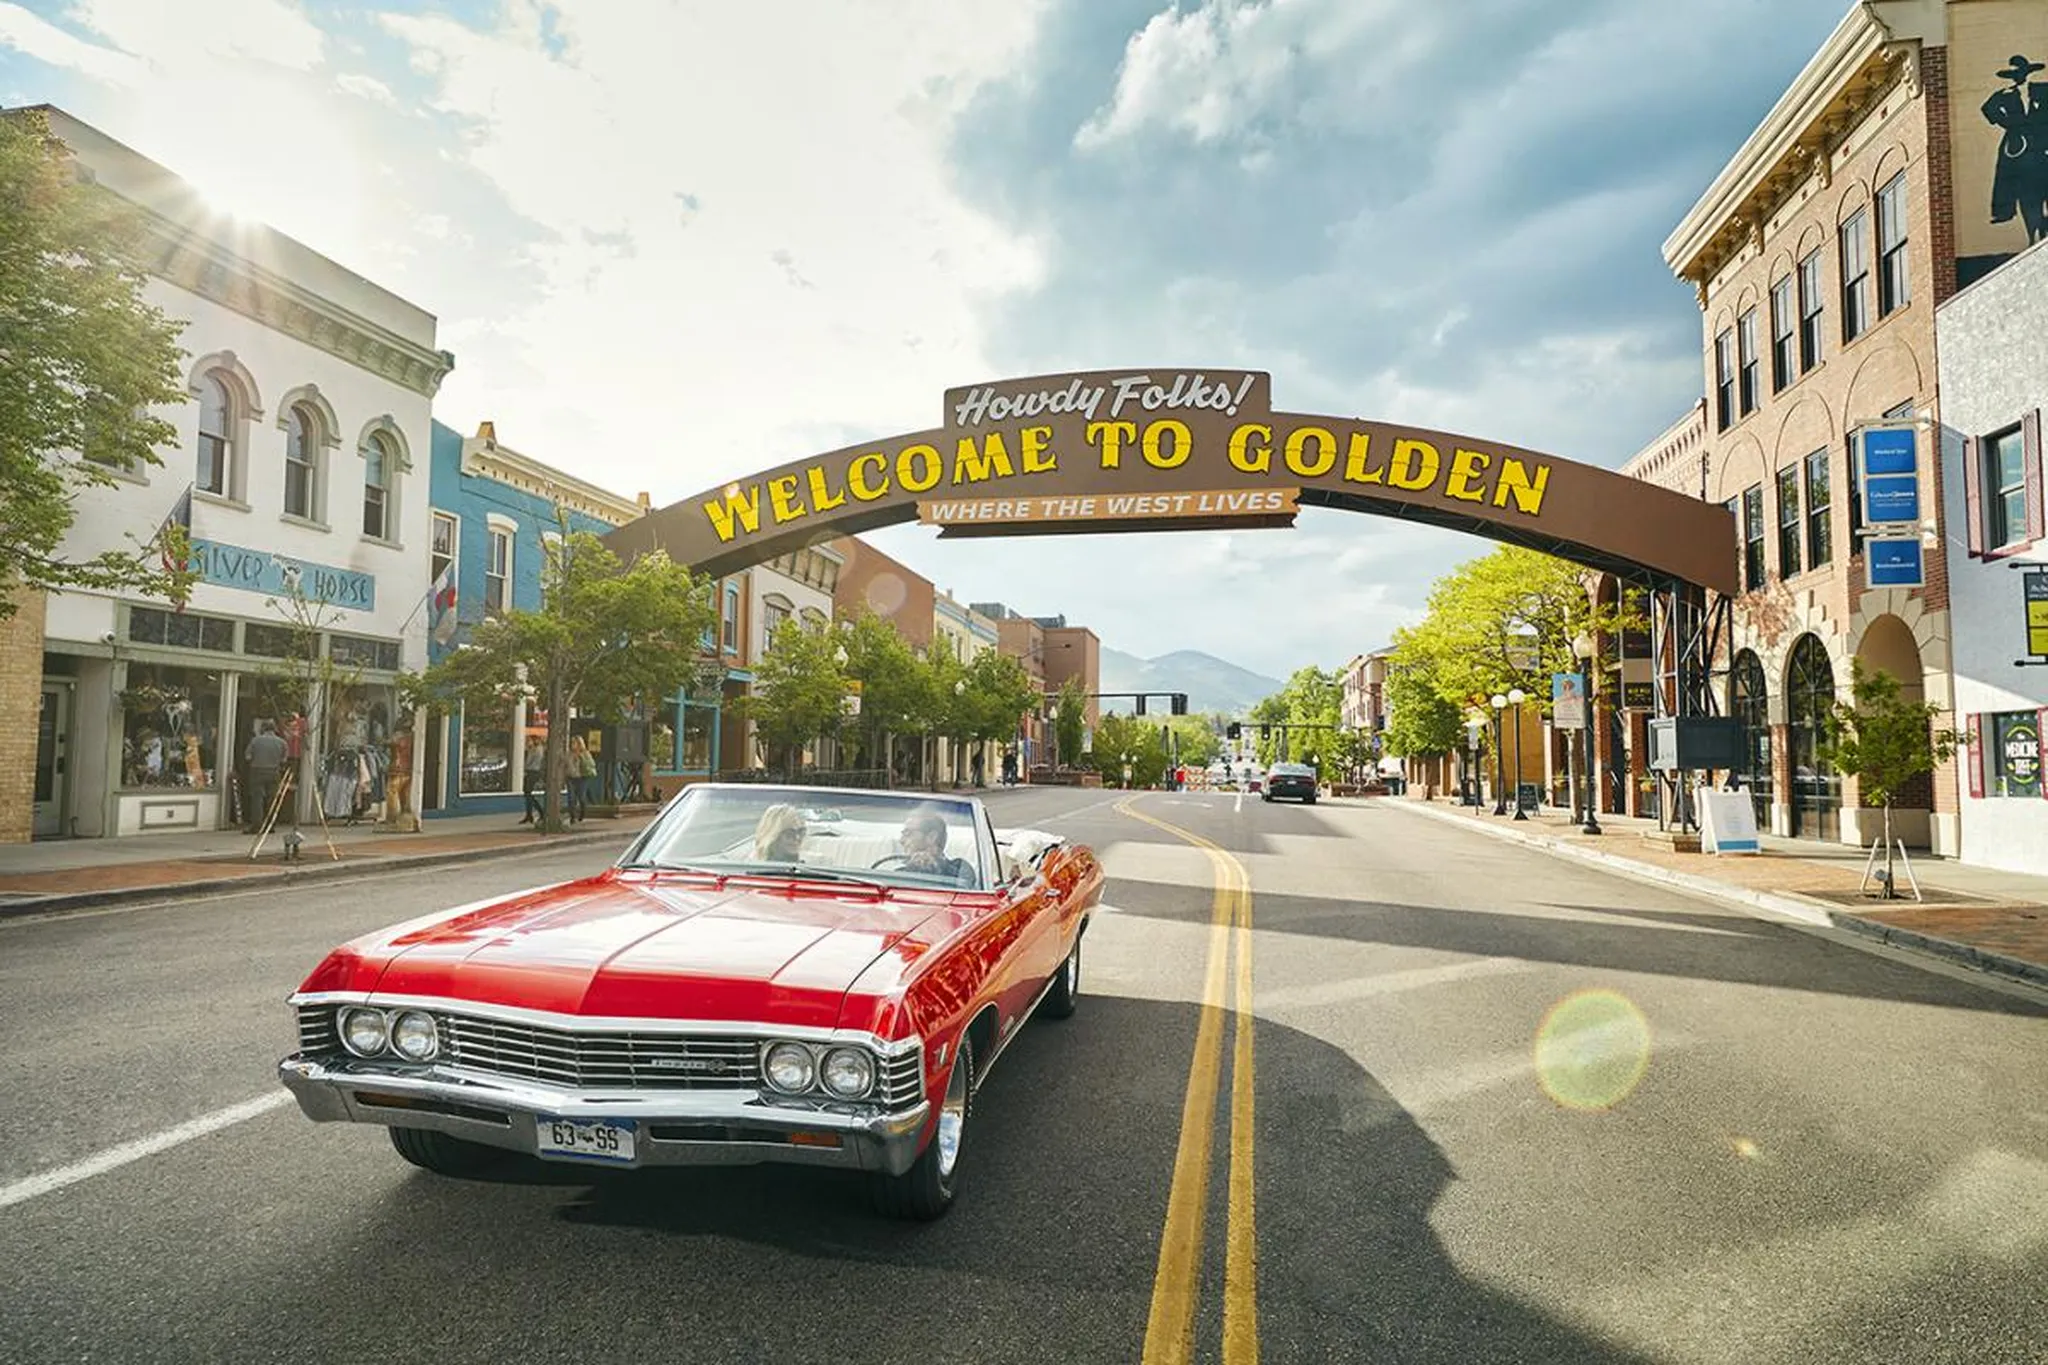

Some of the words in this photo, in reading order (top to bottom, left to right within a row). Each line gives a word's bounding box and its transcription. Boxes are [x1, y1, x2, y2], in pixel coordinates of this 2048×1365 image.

[955, 378, 1105, 427] Howdy
[1111, 374, 1255, 419] Folks!
[703, 424, 1058, 543] WELCOME
[1085, 419, 1192, 469] TO
[1228, 423, 1552, 516] GOLDEN
[931, 501, 1031, 521] WHERE
[1042, 498, 1096, 518] THE
[1107, 495, 1192, 516] WEST
[1198, 491, 1284, 512] LIVES
[188, 545, 262, 588] SILVER
[314, 570, 368, 603] HORSE
[552, 1123, 576, 1146] 63
